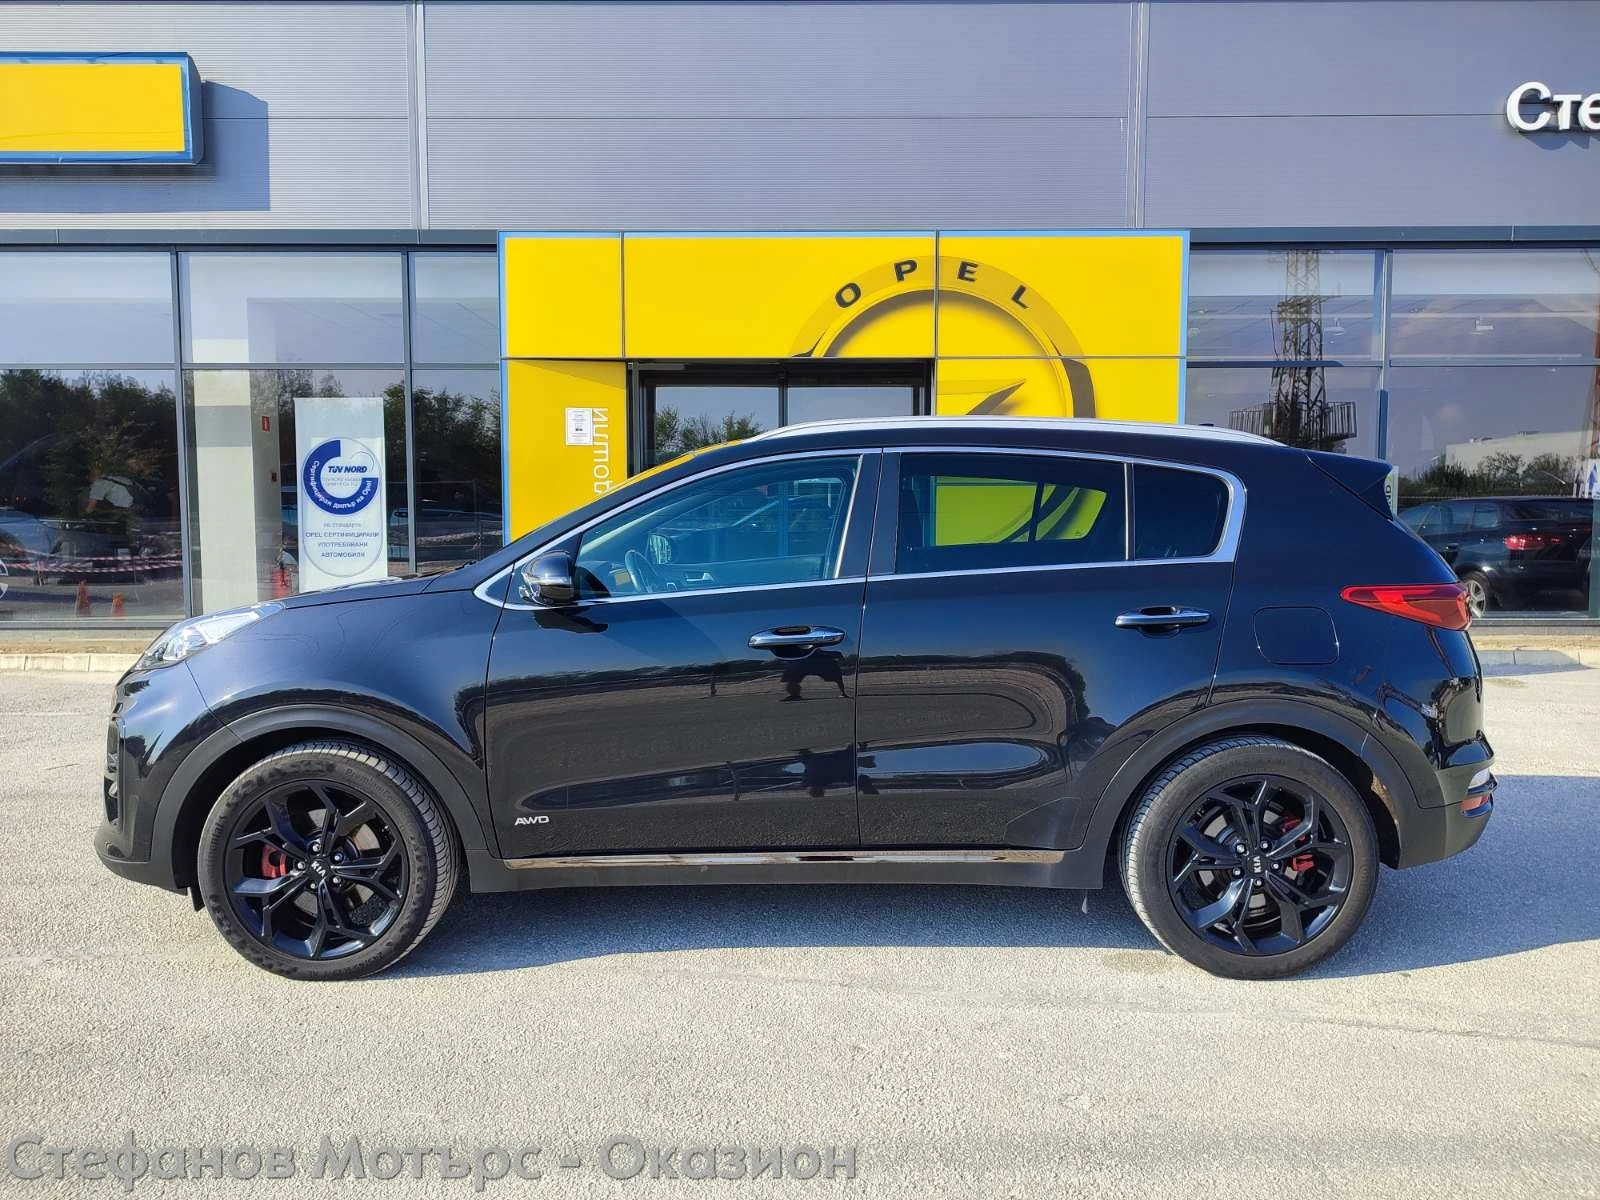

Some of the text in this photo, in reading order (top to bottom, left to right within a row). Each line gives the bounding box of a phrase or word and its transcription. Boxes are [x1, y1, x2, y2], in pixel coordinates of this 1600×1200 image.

[834, 259, 1030, 309] OPEL
[344, 465, 368, 473] NORD
[514, 815, 550, 826] AWD
[311, 860, 326, 877] KIA
